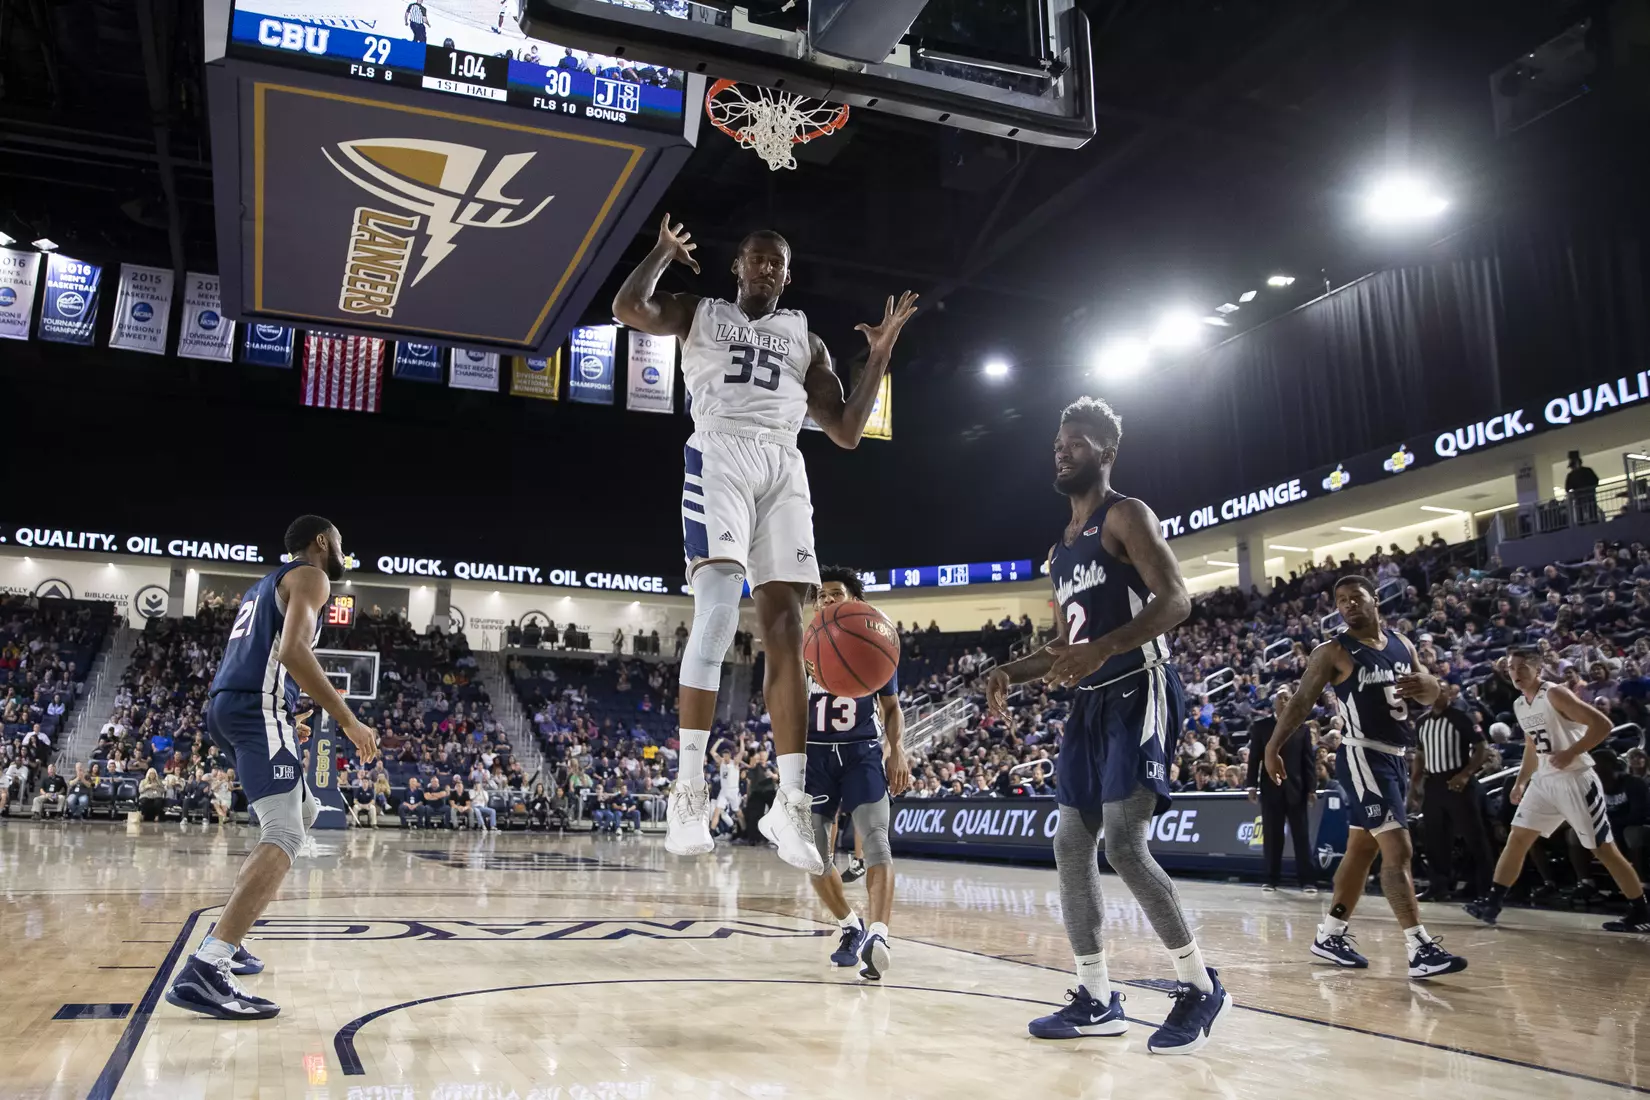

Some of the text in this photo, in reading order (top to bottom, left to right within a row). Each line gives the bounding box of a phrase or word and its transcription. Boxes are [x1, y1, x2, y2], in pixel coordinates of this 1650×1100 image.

[258, 18, 330, 55] CBU
[362, 36, 391, 65] 29
[350, 64, 393, 81] FLS 8
[449, 52, 486, 80] 1:04
[437, 79, 498, 98] 1ST HALF
[545, 70, 571, 97] 30
[533, 97, 576, 114] FLS 10
[586, 107, 627, 123] BONUS
[2, 257, 26, 268] 016
[339, 207, 421, 318] LANCERS
[131, 272, 162, 284] 2015
[132, 284, 157, 293] MEN'S
[197, 281, 219, 291] 201
[119, 324, 154, 334] DIVISION
[723, 344, 784, 391] 35
[1434, 408, 1535, 458] QUICK.
[1189, 506, 1219, 530] OIL
[1221, 478, 1308, 521] CHANGE.
[15, 527, 118, 551] QUALITY.
[126, 536, 162, 555] OIL
[168, 539, 264, 563] CHANGE.
[377, 556, 669, 593] QUICK. QUALITY. OIL CHANGE.
[904, 569, 920, 586] 30
[1073, 560, 1106, 594] State
[84, 591, 129, 600] BIBLICALLY
[334, 596, 354, 608] 1:03
[229, 595, 260, 641] 21
[328, 606, 349, 625] 30
[470, 617, 505, 625] EQUIPPED
[1066, 601, 1090, 646] 2
[815, 695, 857, 732] 13
[1383, 685, 1408, 722] 5
[315, 739, 331, 788] CBU
[894, 808, 946, 835] QUICK.
[952, 809, 1037, 838] QUALITY.
